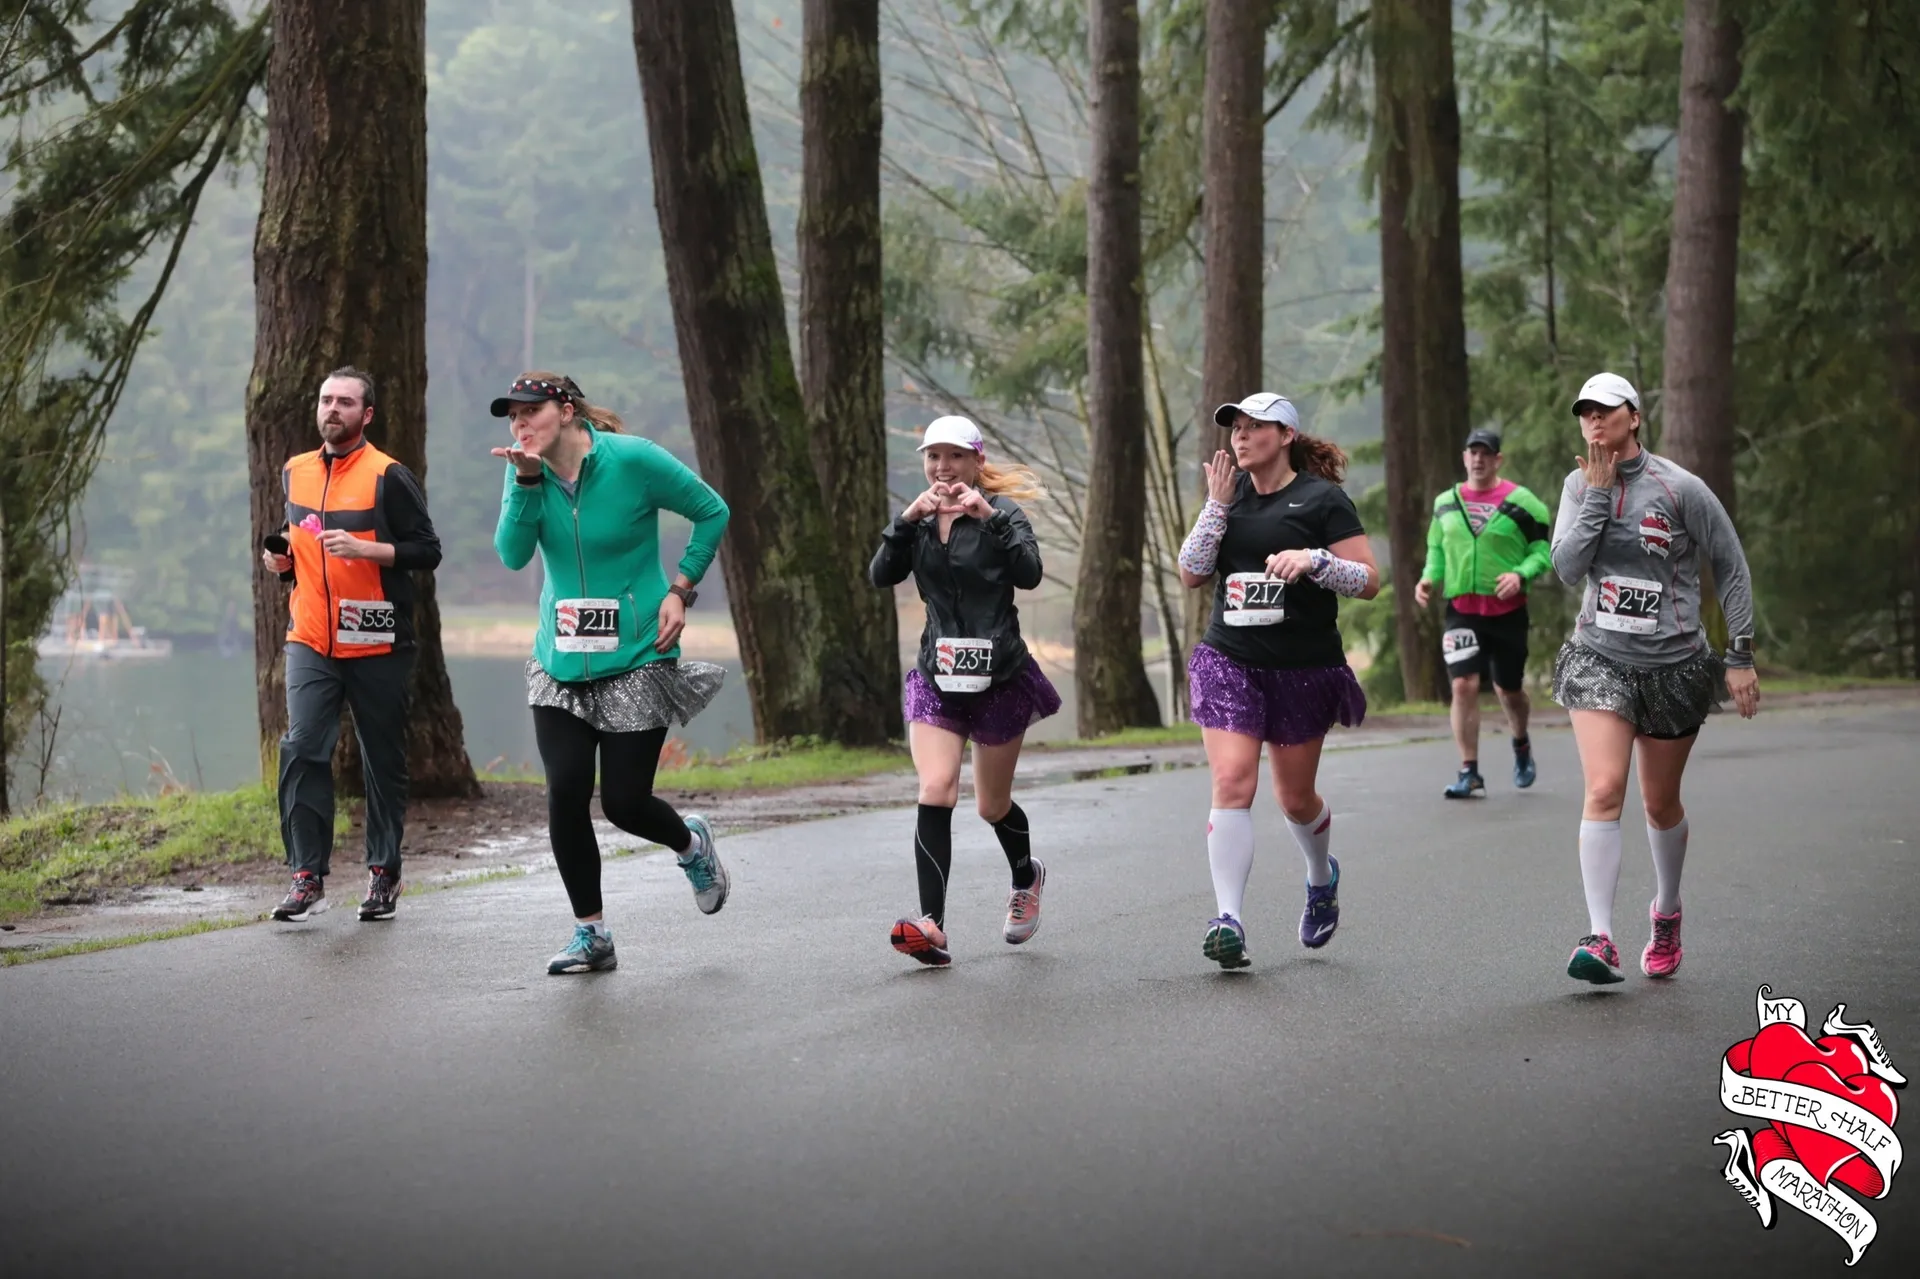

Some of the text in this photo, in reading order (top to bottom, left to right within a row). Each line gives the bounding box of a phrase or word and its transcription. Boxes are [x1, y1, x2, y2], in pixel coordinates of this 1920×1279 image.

[1247, 582, 1284, 604] 217
[1619, 588, 1660, 614] 242
[363, 609, 395, 628] 556
[583, 609, 616, 631] 211
[956, 649, 992, 671] 234
